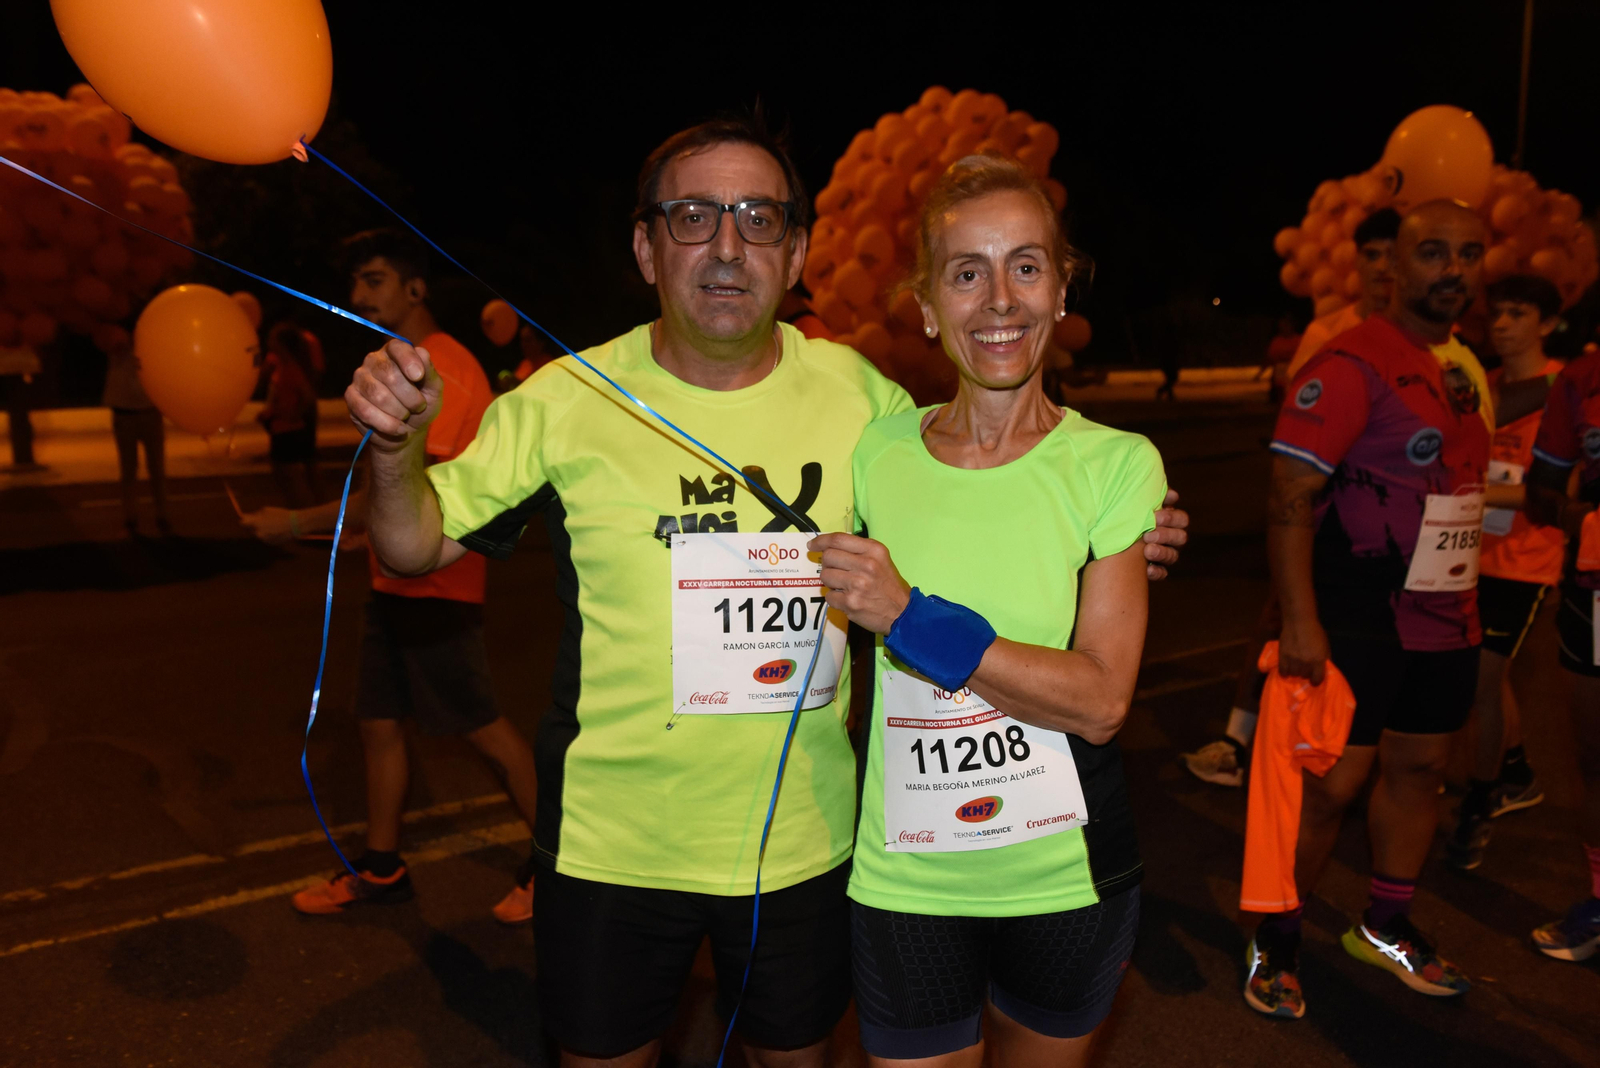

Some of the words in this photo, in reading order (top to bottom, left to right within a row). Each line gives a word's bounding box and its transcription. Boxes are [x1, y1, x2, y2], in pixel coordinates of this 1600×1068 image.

[703, 580, 734, 588] CARRERA
[714, 596, 827, 634] 11207
[723, 642, 756, 651] RAMON
[758, 641, 790, 650] GARCIA
[902, 719, 925, 727] CARRERA
[925, 719, 961, 728] NOCTURNA
[962, 717, 975, 726] DEL
[975, 711, 1004, 723] GUADALQ
[910, 725, 1031, 774] 11208
[905, 782, 931, 791] MARIA
[933, 780, 970, 791] BEGOÑA
[972, 775, 1008, 787] MERINO
[1010, 766, 1046, 781] ALVAREZ
[1026, 812, 1077, 830] Cruzcampo
